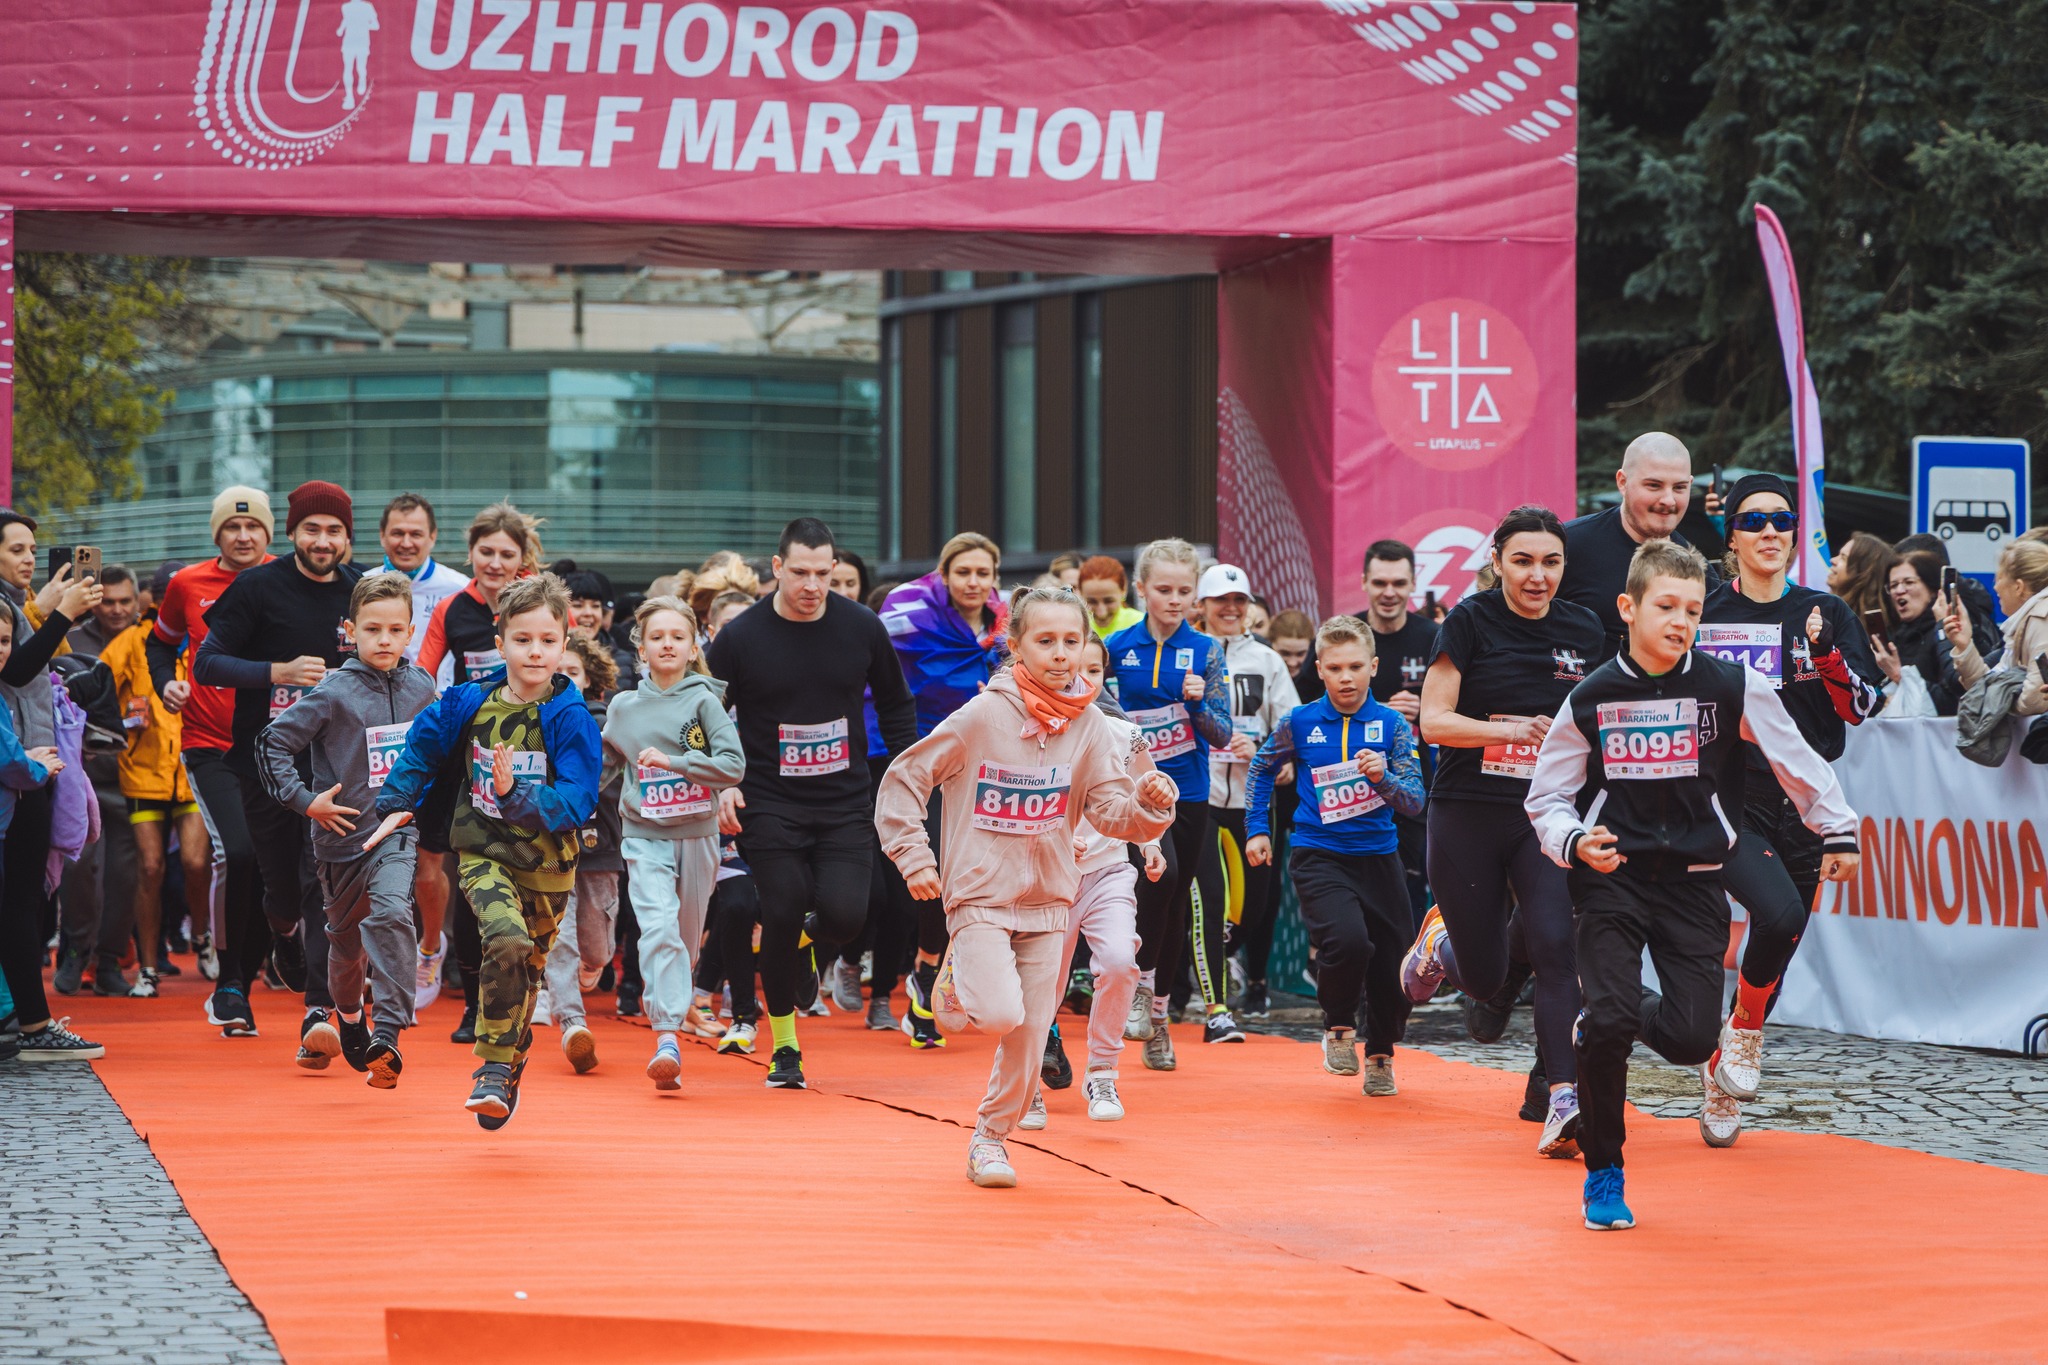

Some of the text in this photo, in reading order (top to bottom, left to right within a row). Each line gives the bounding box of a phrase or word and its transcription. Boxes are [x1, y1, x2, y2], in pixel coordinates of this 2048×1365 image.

[410, 0, 919, 82] UZHHOROD
[409, 91, 1164, 181] HALF MARATHON
[1620, 714, 1669, 723] MARATHON
[1675, 701, 1682, 720] 1
[785, 741, 842, 764] 8185
[1606, 730, 1692, 759] 8095
[528, 754, 534, 771] 1
[1000, 775, 1046, 786] MARATHON
[1050, 768, 1056, 784] 1
[646, 781, 704, 805] 8034
[983, 789, 1061, 818] 8102
[1322, 780, 1378, 809] 809
